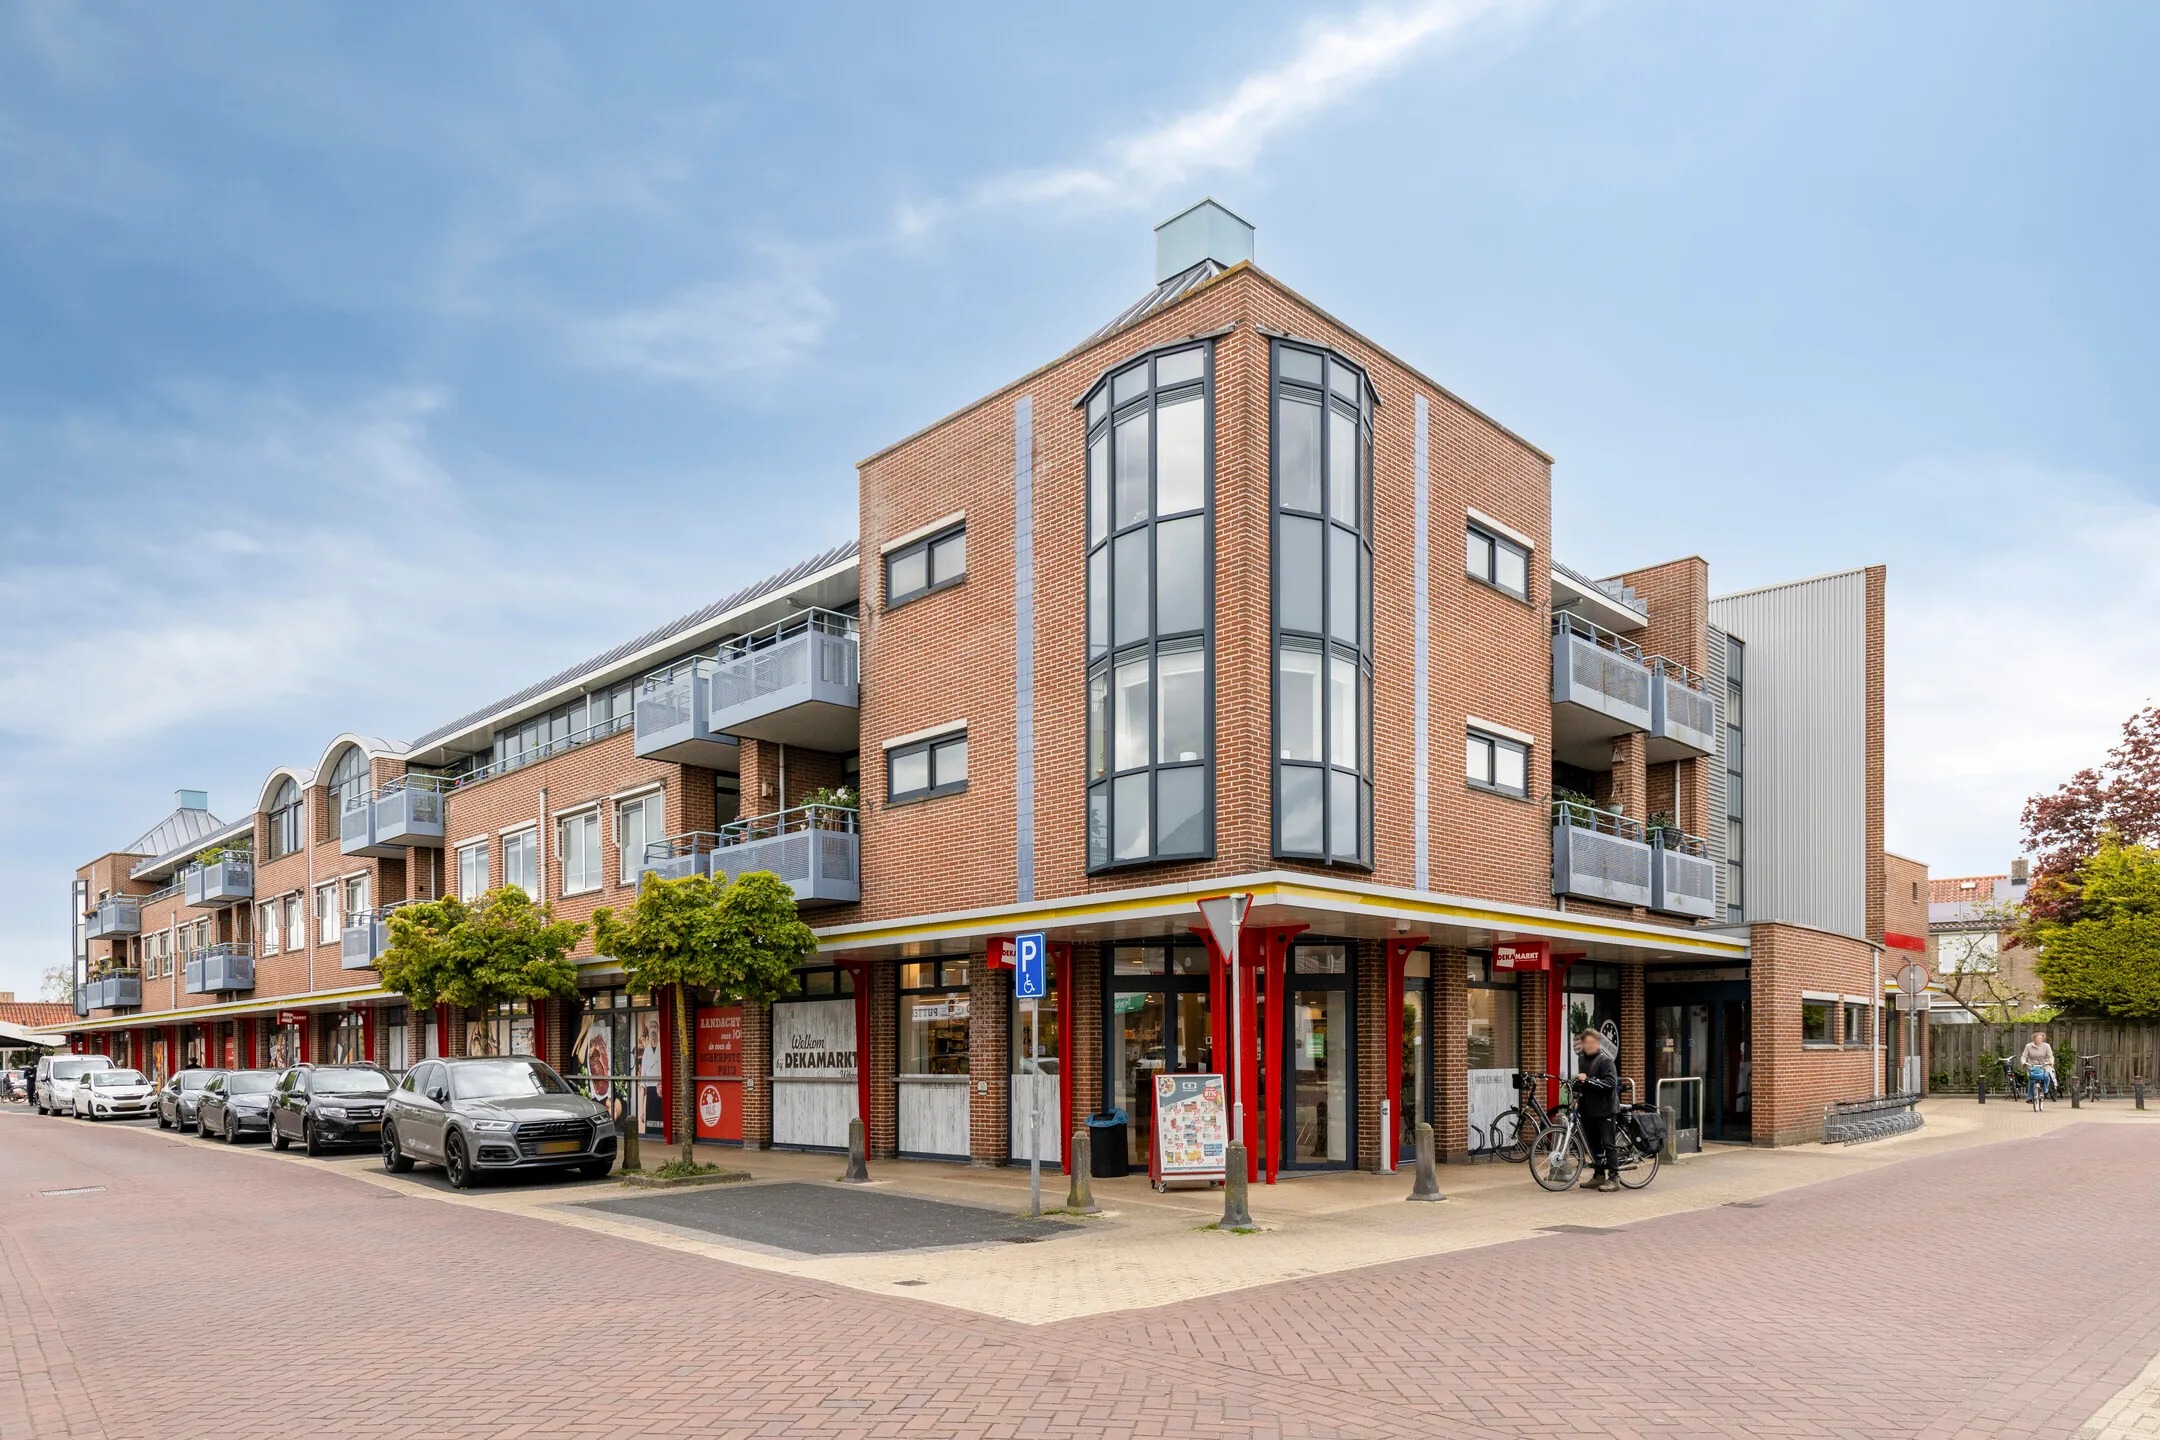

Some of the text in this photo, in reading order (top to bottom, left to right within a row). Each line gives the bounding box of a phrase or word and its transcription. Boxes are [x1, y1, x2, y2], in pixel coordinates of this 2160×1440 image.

[1022, 941, 1036, 972] P
[1498, 952, 1539, 960] DEKAMARKT
[700, 1017, 741, 1028] AANDACHT
[725, 1041, 732, 1050] de
[791, 1034, 825, 1050] Welkom
[699, 1052, 741, 1063] SCHERPSTE
[785, 1051, 857, 1069] DEKAMARKT
